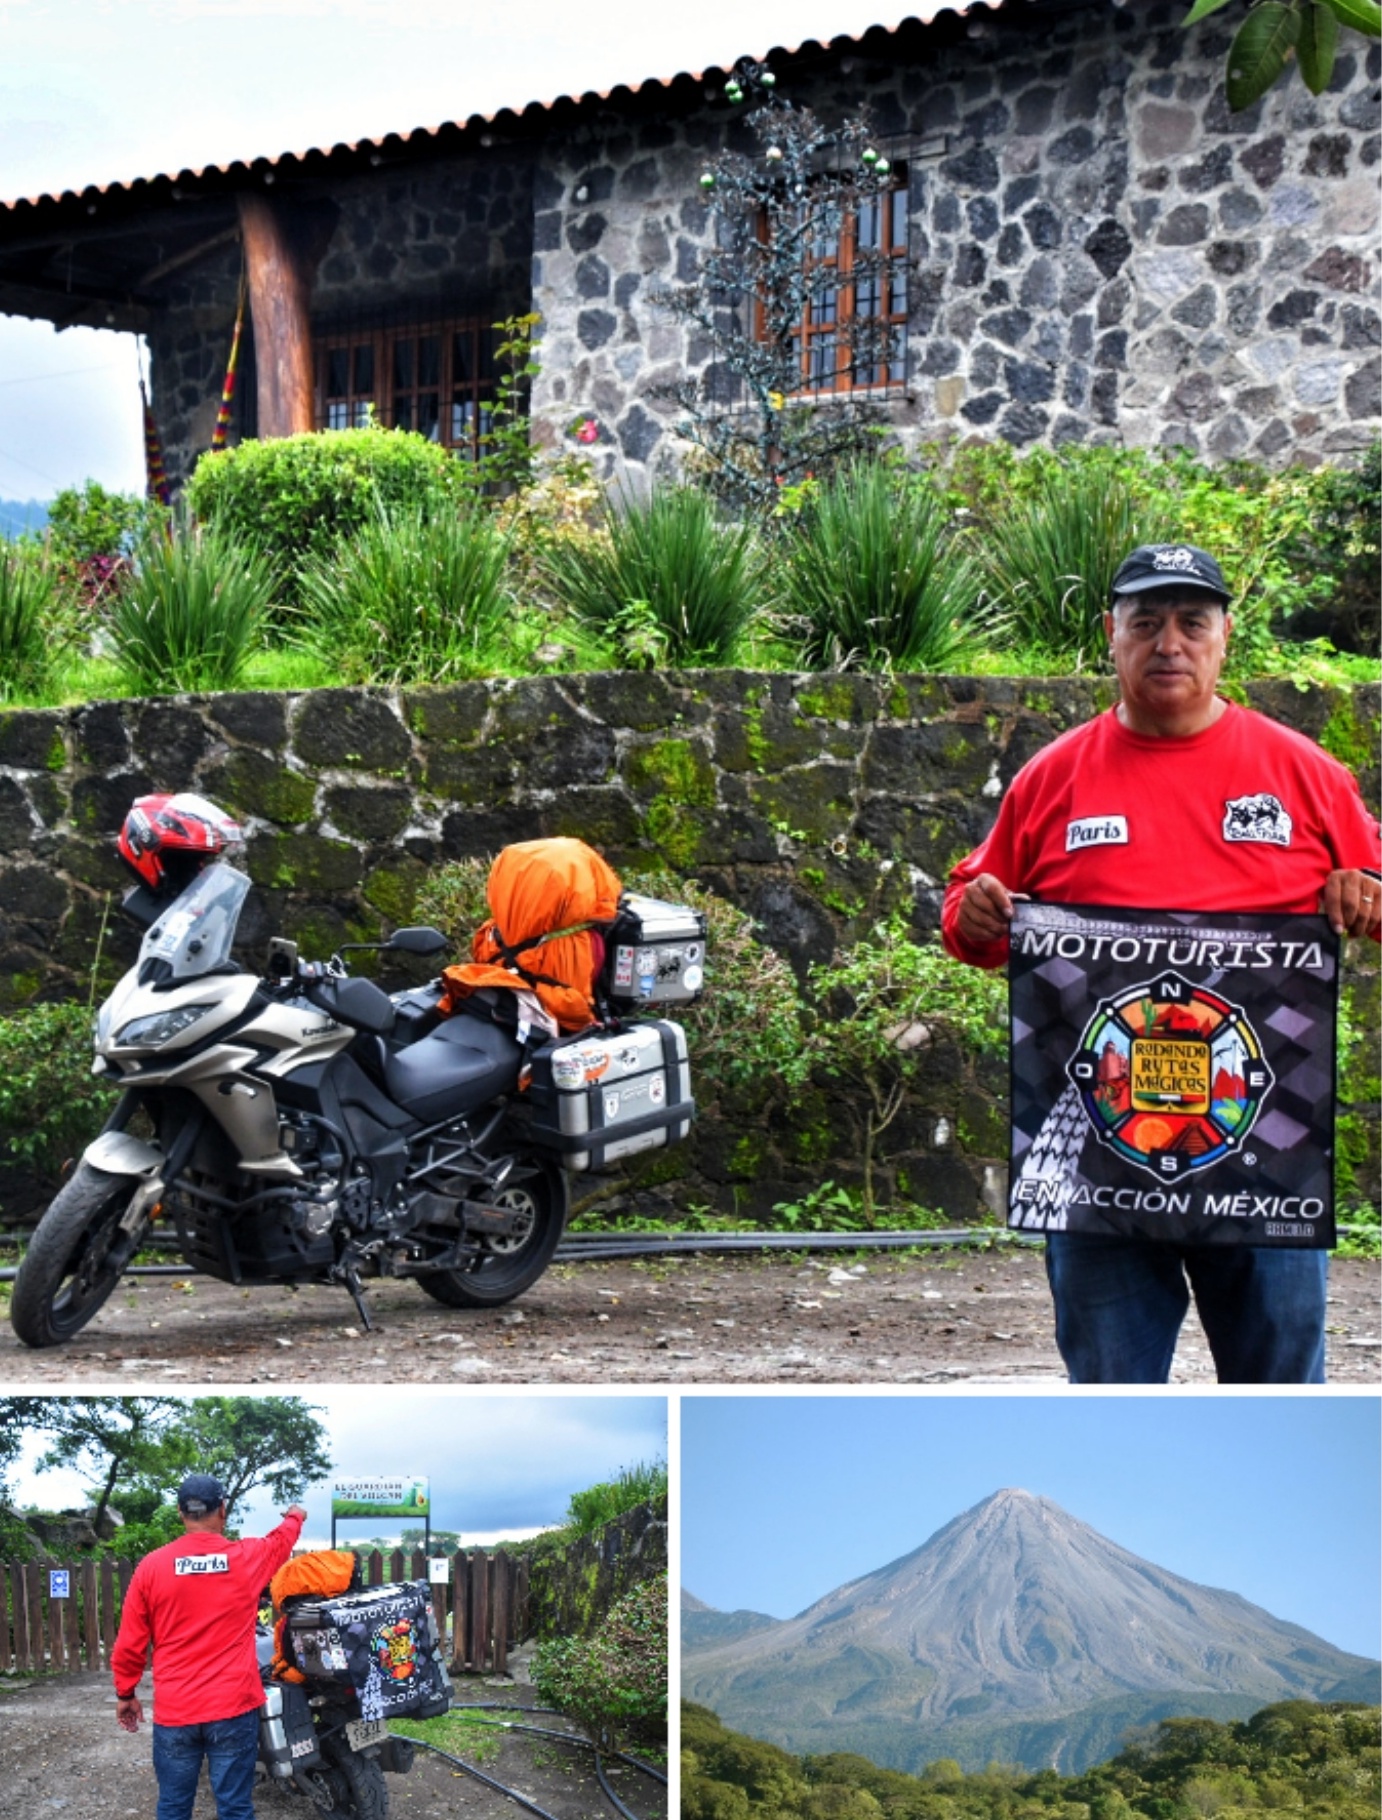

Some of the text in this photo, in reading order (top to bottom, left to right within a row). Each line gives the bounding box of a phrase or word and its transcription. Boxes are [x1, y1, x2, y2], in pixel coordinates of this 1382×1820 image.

[1070, 821, 1122, 845] Paris
[1020, 929, 1324, 969] MOTOTURISTA
[1161, 983, 1181, 998] N
[1249, 1071, 1266, 1087] E
[1159, 1155, 1178, 1172] S
[1017, 1179, 1324, 1219] EN ACCIÓN MÉXICO
